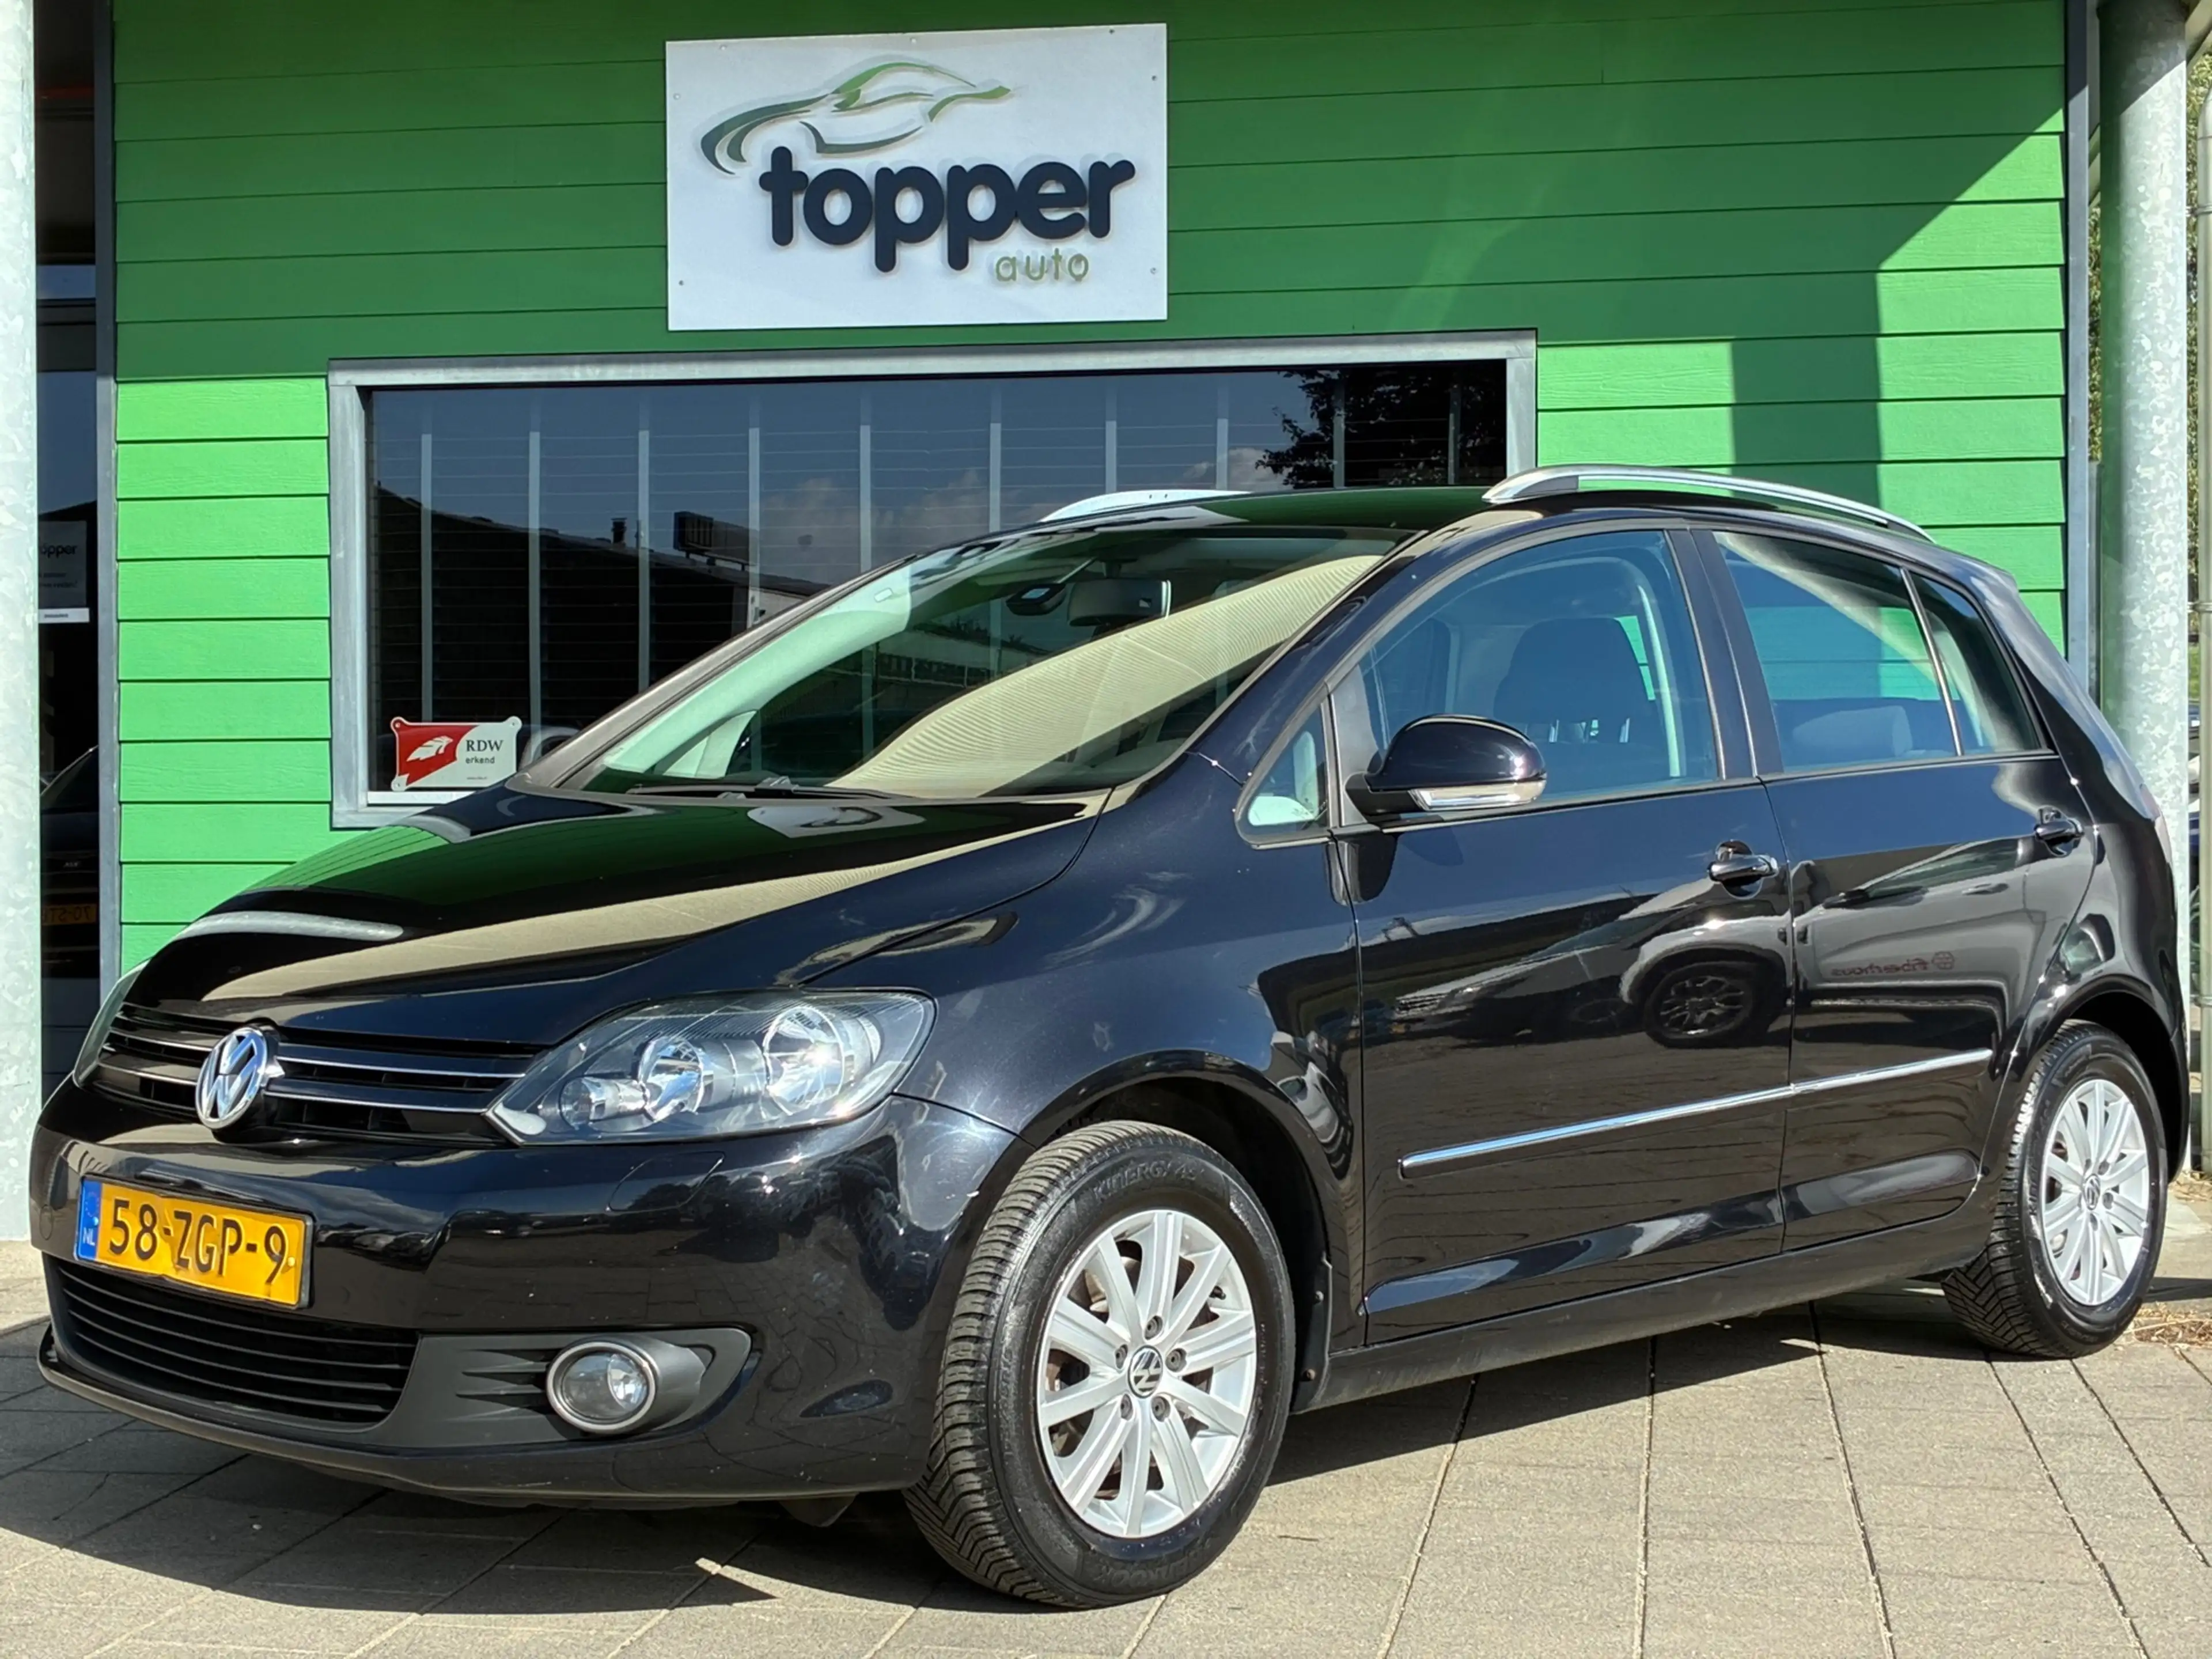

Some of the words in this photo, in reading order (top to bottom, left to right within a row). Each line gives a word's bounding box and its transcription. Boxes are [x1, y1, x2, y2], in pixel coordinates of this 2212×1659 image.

[759, 146, 1137, 273] topper
[995, 248, 1089, 283] auto
[40, 542, 78, 558] opper
[465, 739, 504, 752] RDW
[465, 755, 495, 764] erkend
[82, 1226, 96, 1247] NL
[109, 1198, 287, 1285] 58-ZGP-9
